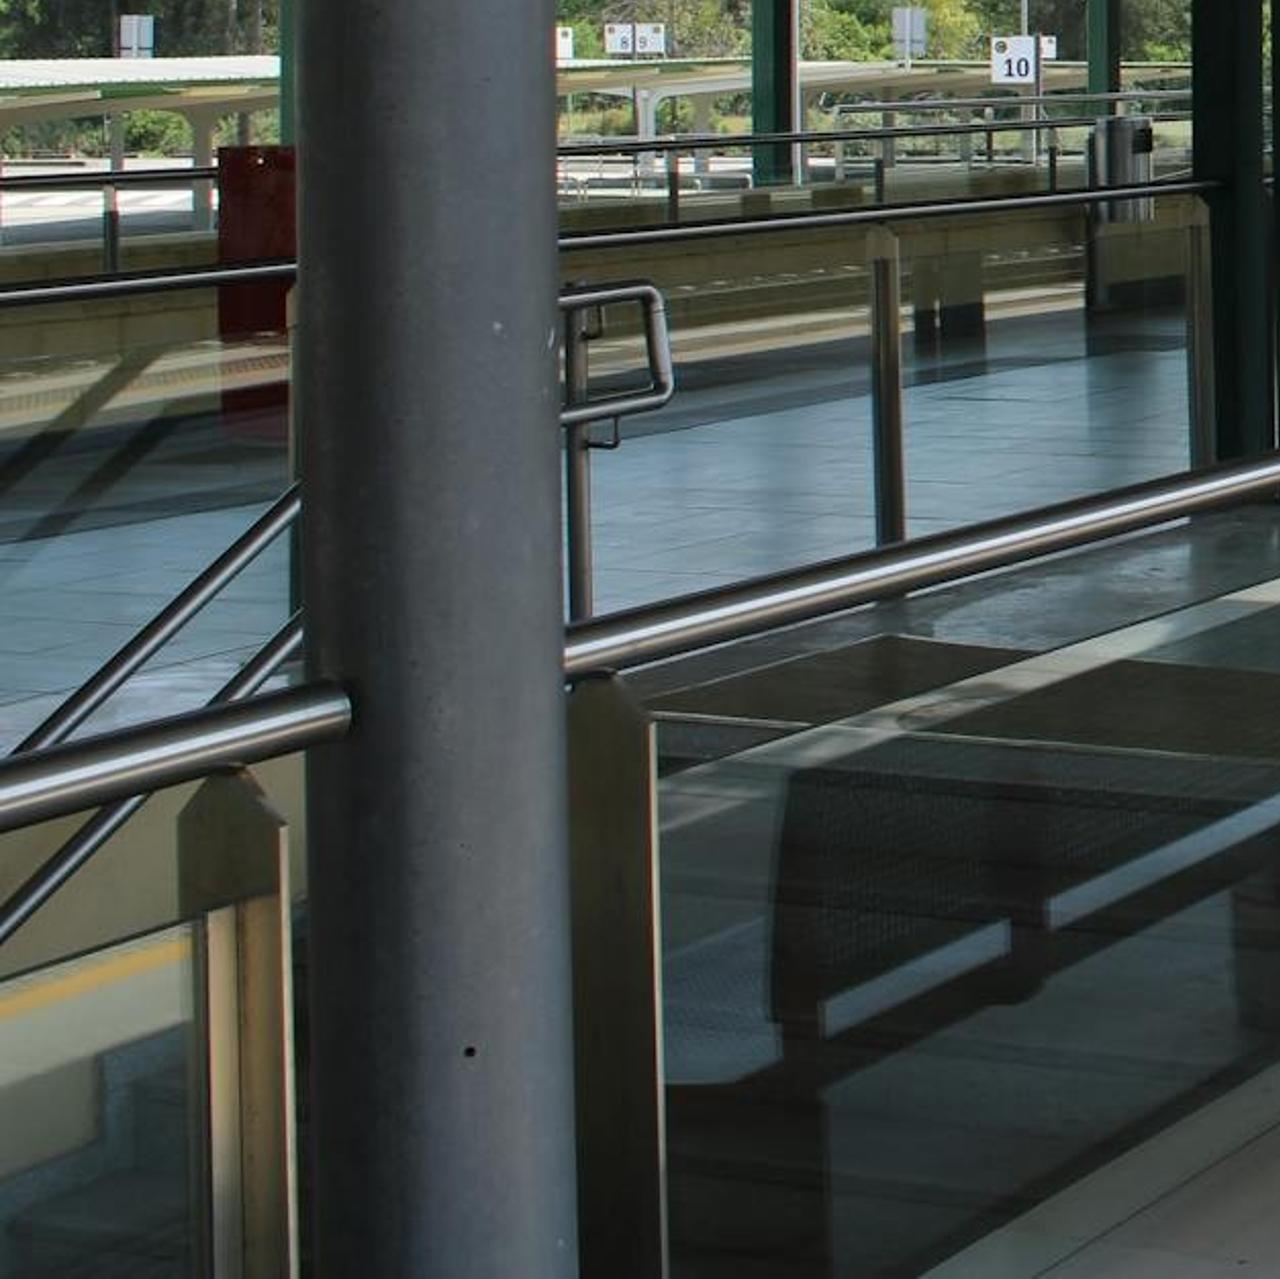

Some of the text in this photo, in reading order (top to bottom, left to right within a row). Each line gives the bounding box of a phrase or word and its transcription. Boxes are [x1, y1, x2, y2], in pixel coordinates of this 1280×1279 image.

[620, 36, 630, 49] 8
[639, 36, 648, 49] 9
[1004, 57, 1030, 77] 10
